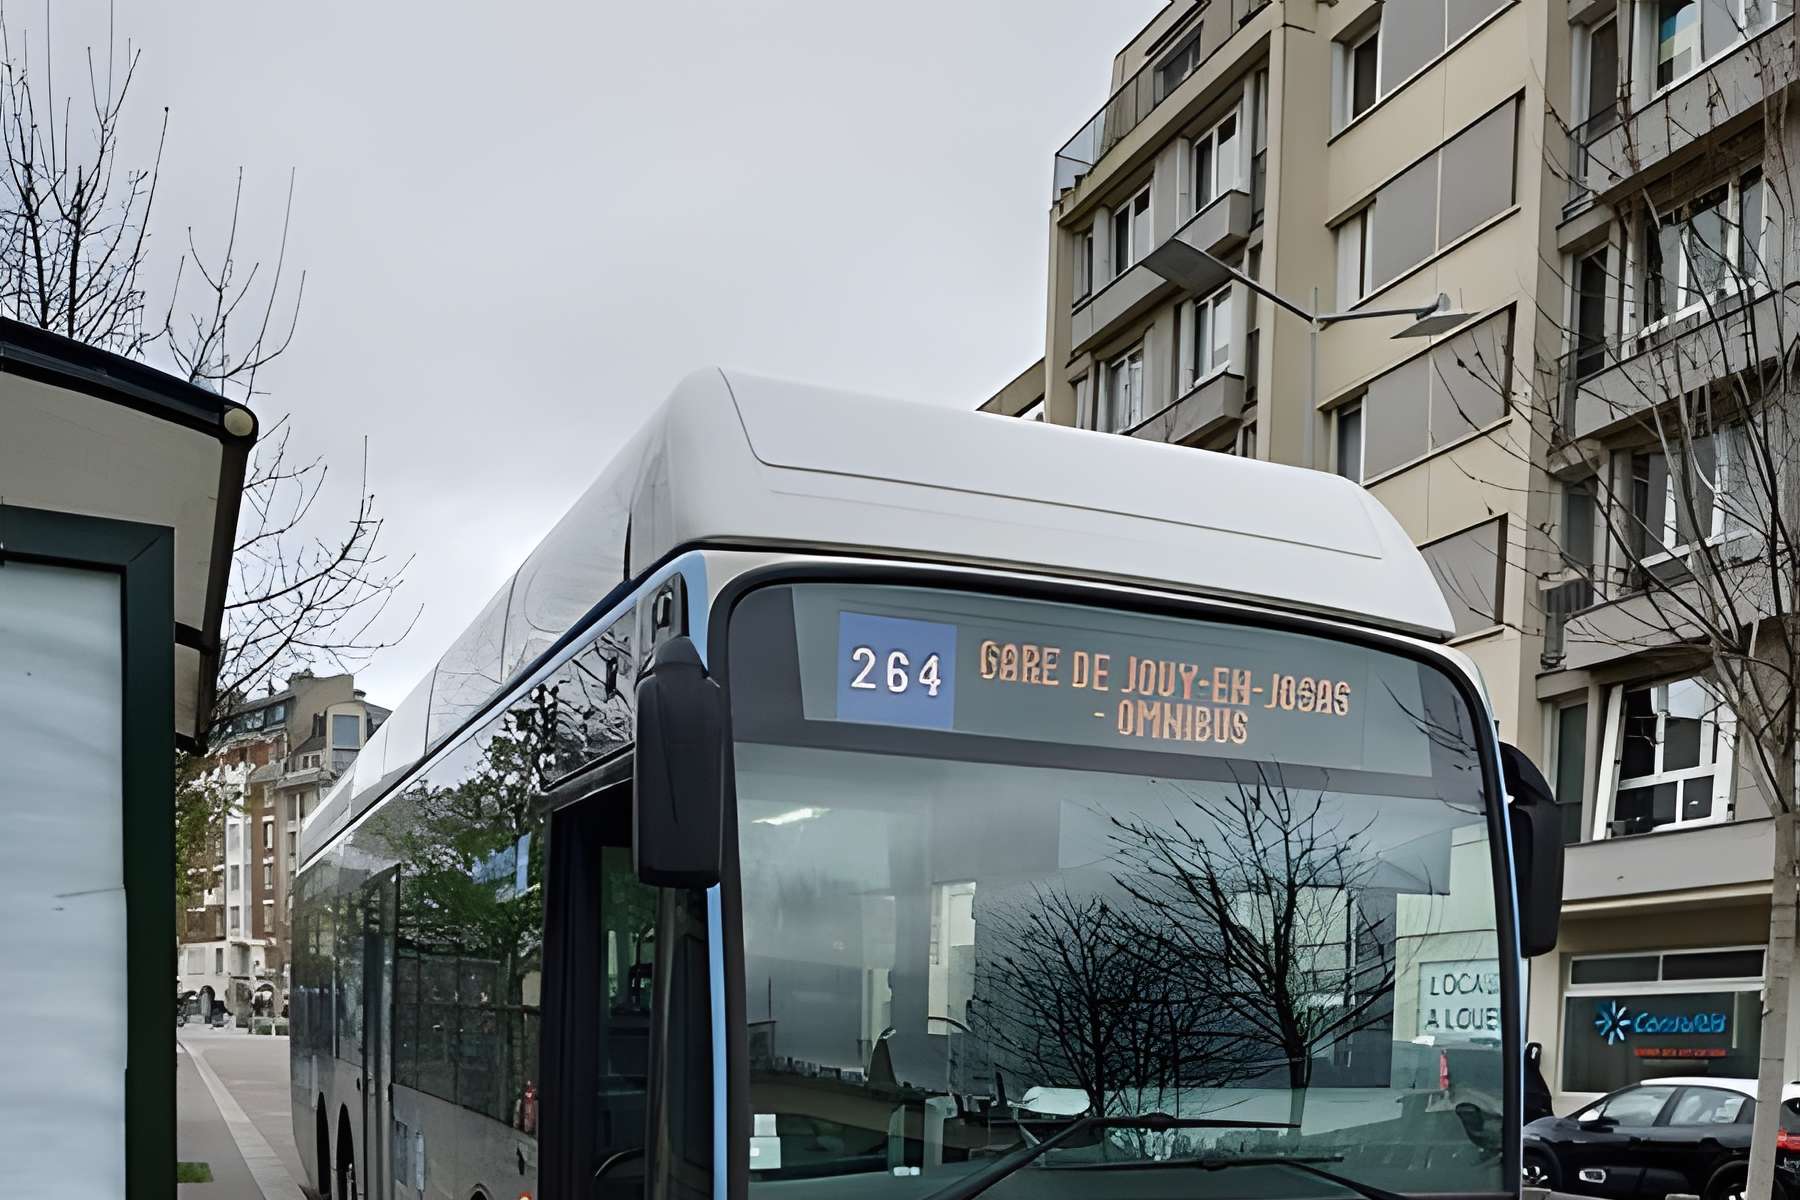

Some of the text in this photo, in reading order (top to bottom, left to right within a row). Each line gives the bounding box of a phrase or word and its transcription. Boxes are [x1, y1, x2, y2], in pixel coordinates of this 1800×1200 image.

[850, 646, 942, 697] 264
[979, 639, 1061, 687] GARE
[1071, 650, 1111, 692] DE
[1117, 699, 1249, 745] OMNIBUS
